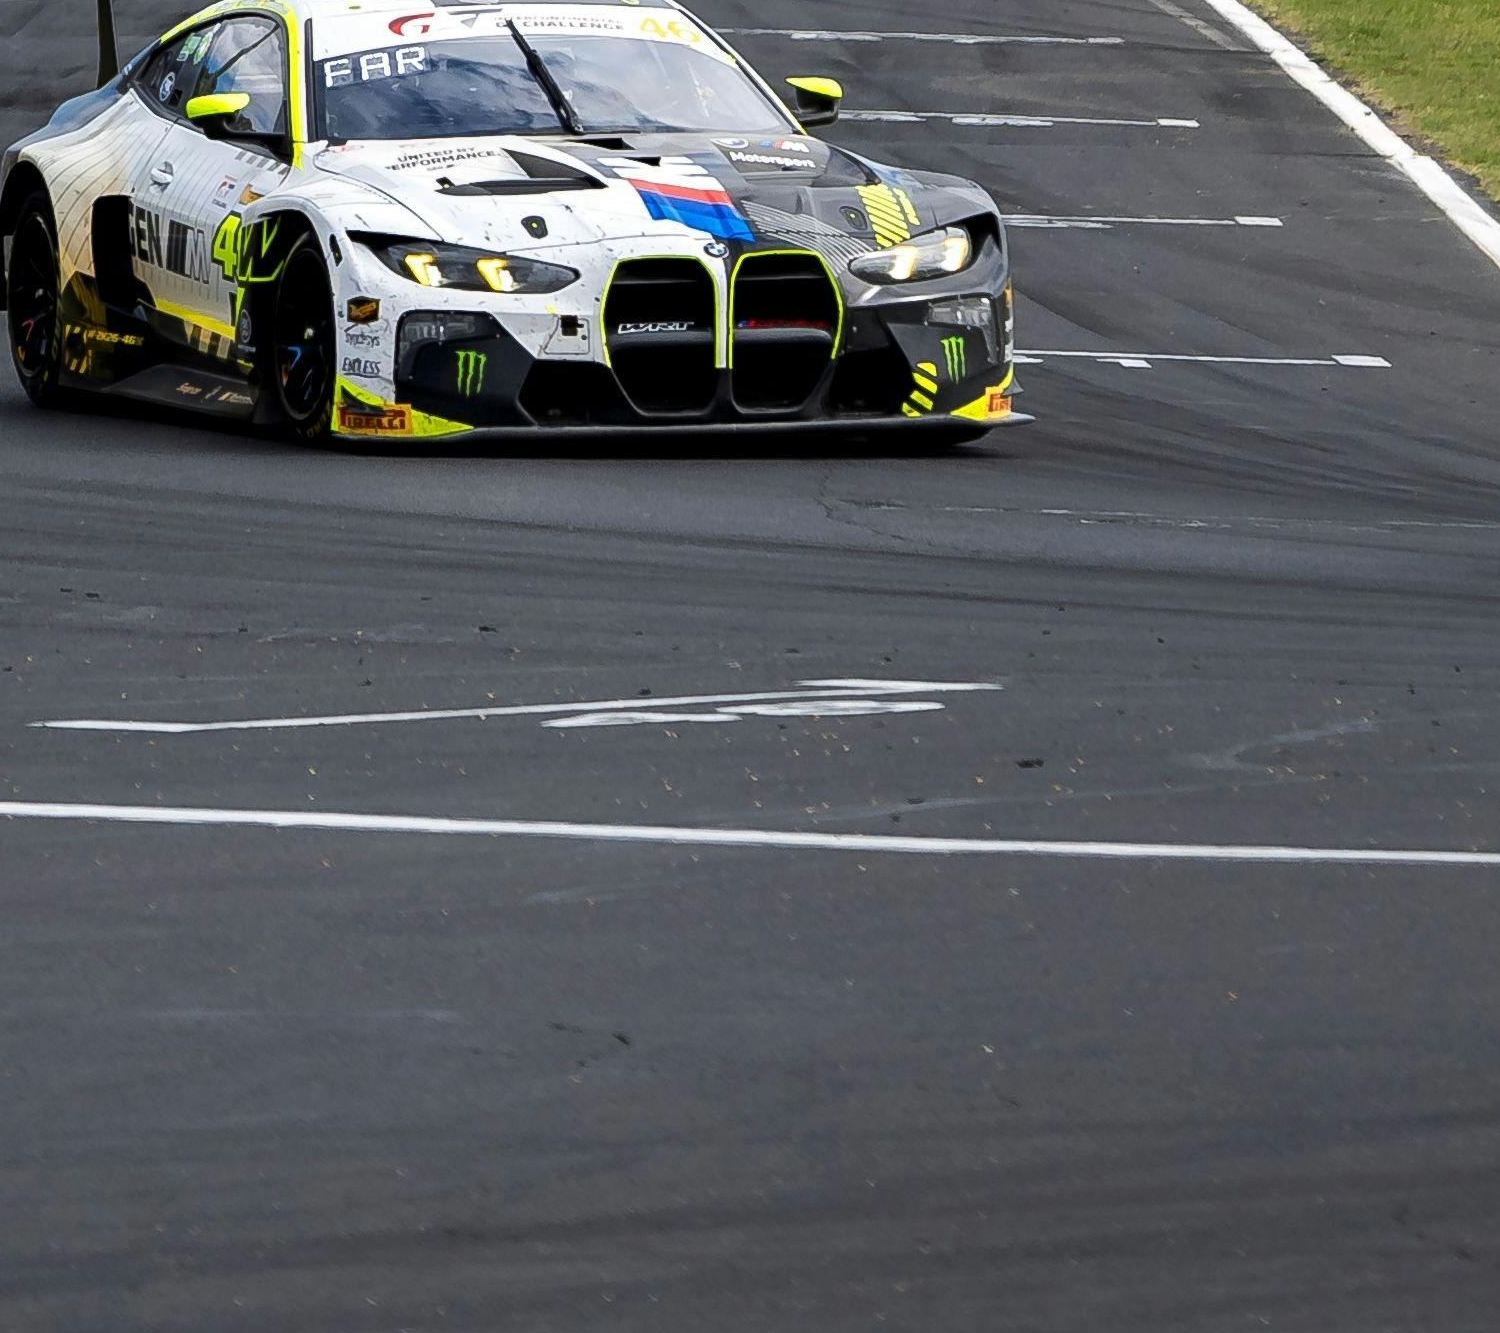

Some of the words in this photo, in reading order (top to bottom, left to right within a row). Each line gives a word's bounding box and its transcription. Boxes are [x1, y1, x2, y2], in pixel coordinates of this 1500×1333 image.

[639, 16, 701, 43] 46
[323, 46, 426, 88] FAR
[397, 148, 451, 164] UNITED
[618, 321, 695, 334] WRT
[339, 408, 407, 431] PIRELLI
